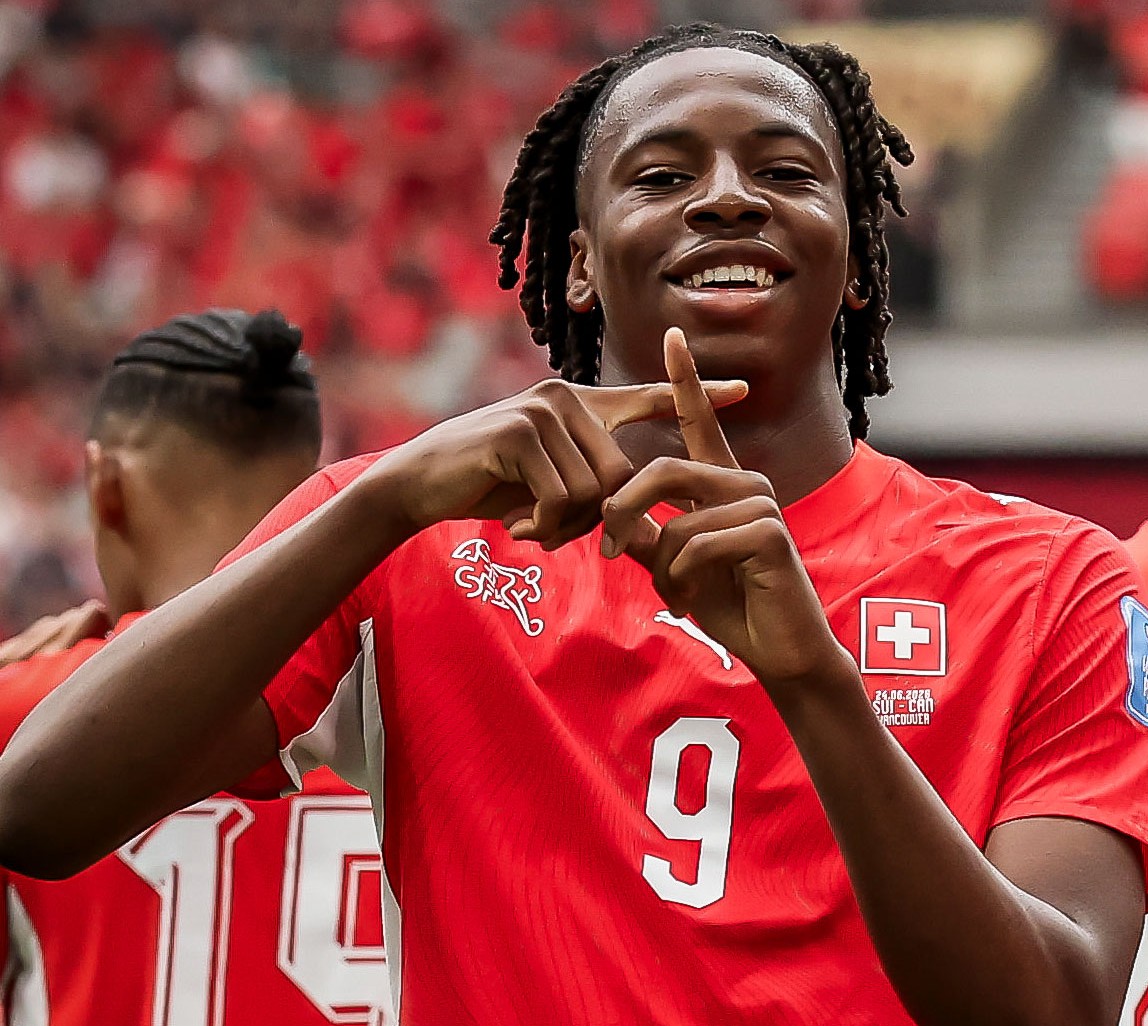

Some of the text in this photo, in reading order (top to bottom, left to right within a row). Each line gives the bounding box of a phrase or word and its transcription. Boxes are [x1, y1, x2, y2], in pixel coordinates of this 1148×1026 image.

[872, 699, 894, 714] SUI
[908, 698, 934, 713] CAN
[641, 717, 740, 909] 9
